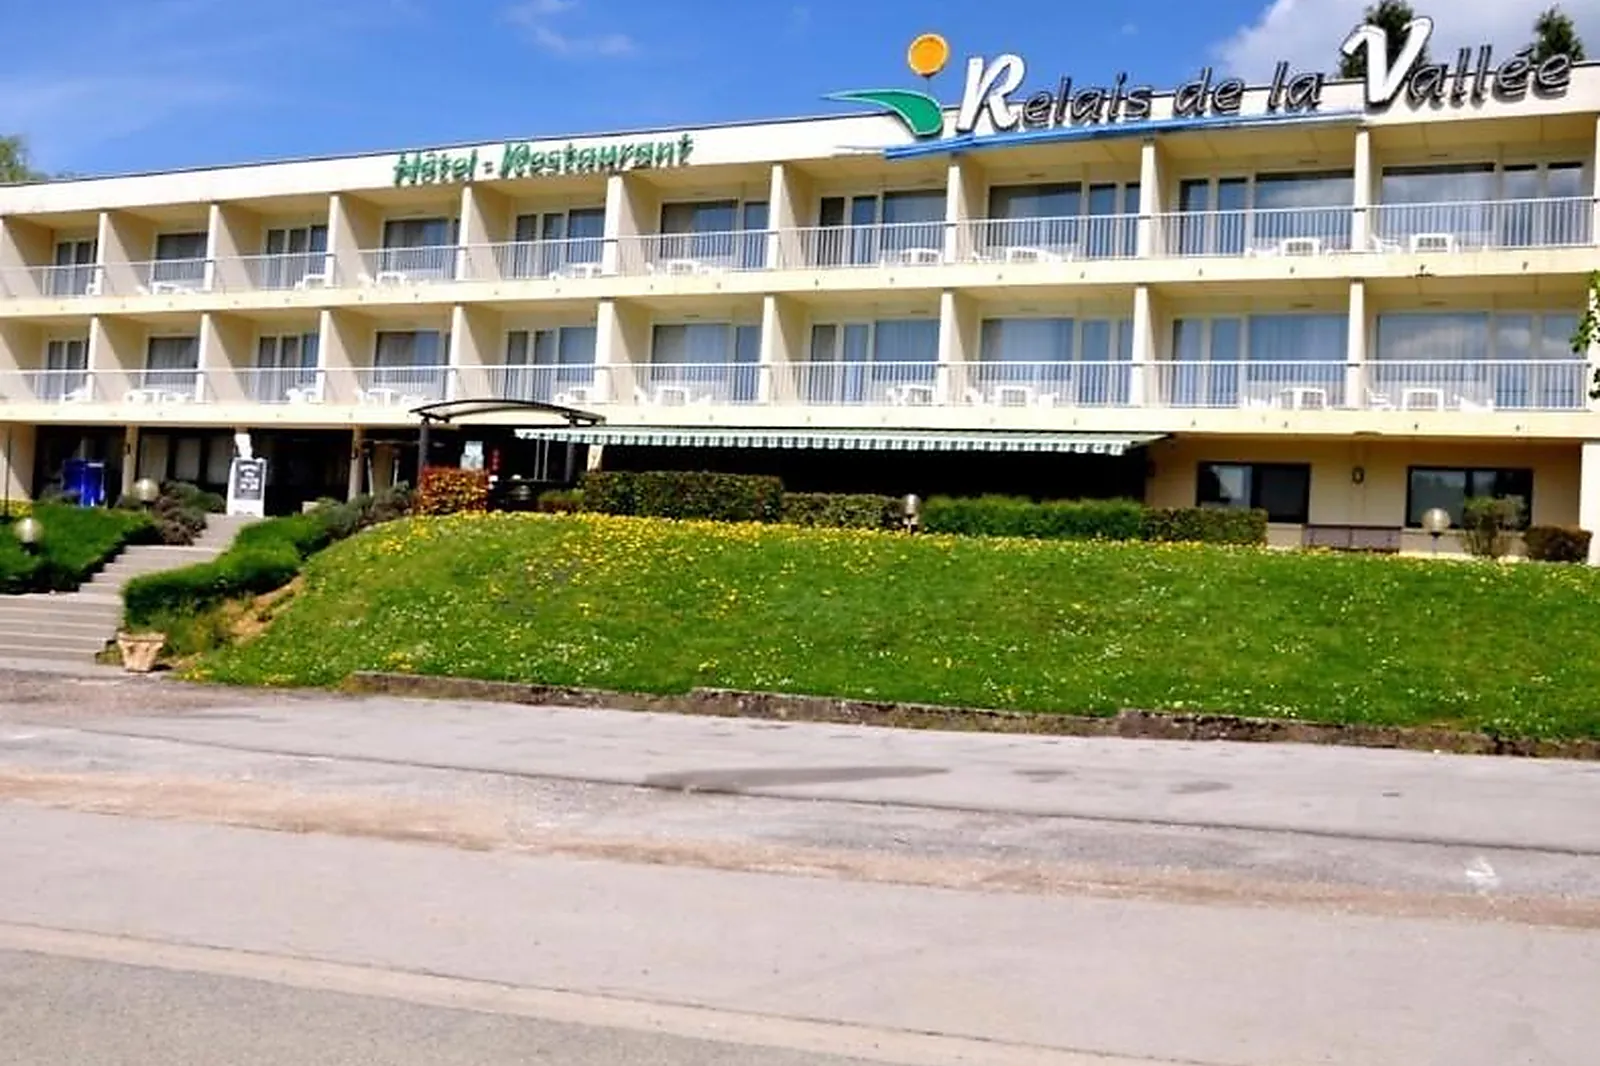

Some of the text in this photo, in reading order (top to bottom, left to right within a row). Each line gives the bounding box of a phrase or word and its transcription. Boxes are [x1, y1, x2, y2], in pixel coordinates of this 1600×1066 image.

[956, 16, 1572, 131] Relais de la Vallée
[394, 148, 478, 187] Hôtel
[500, 133, 694, 178] Restaurant
